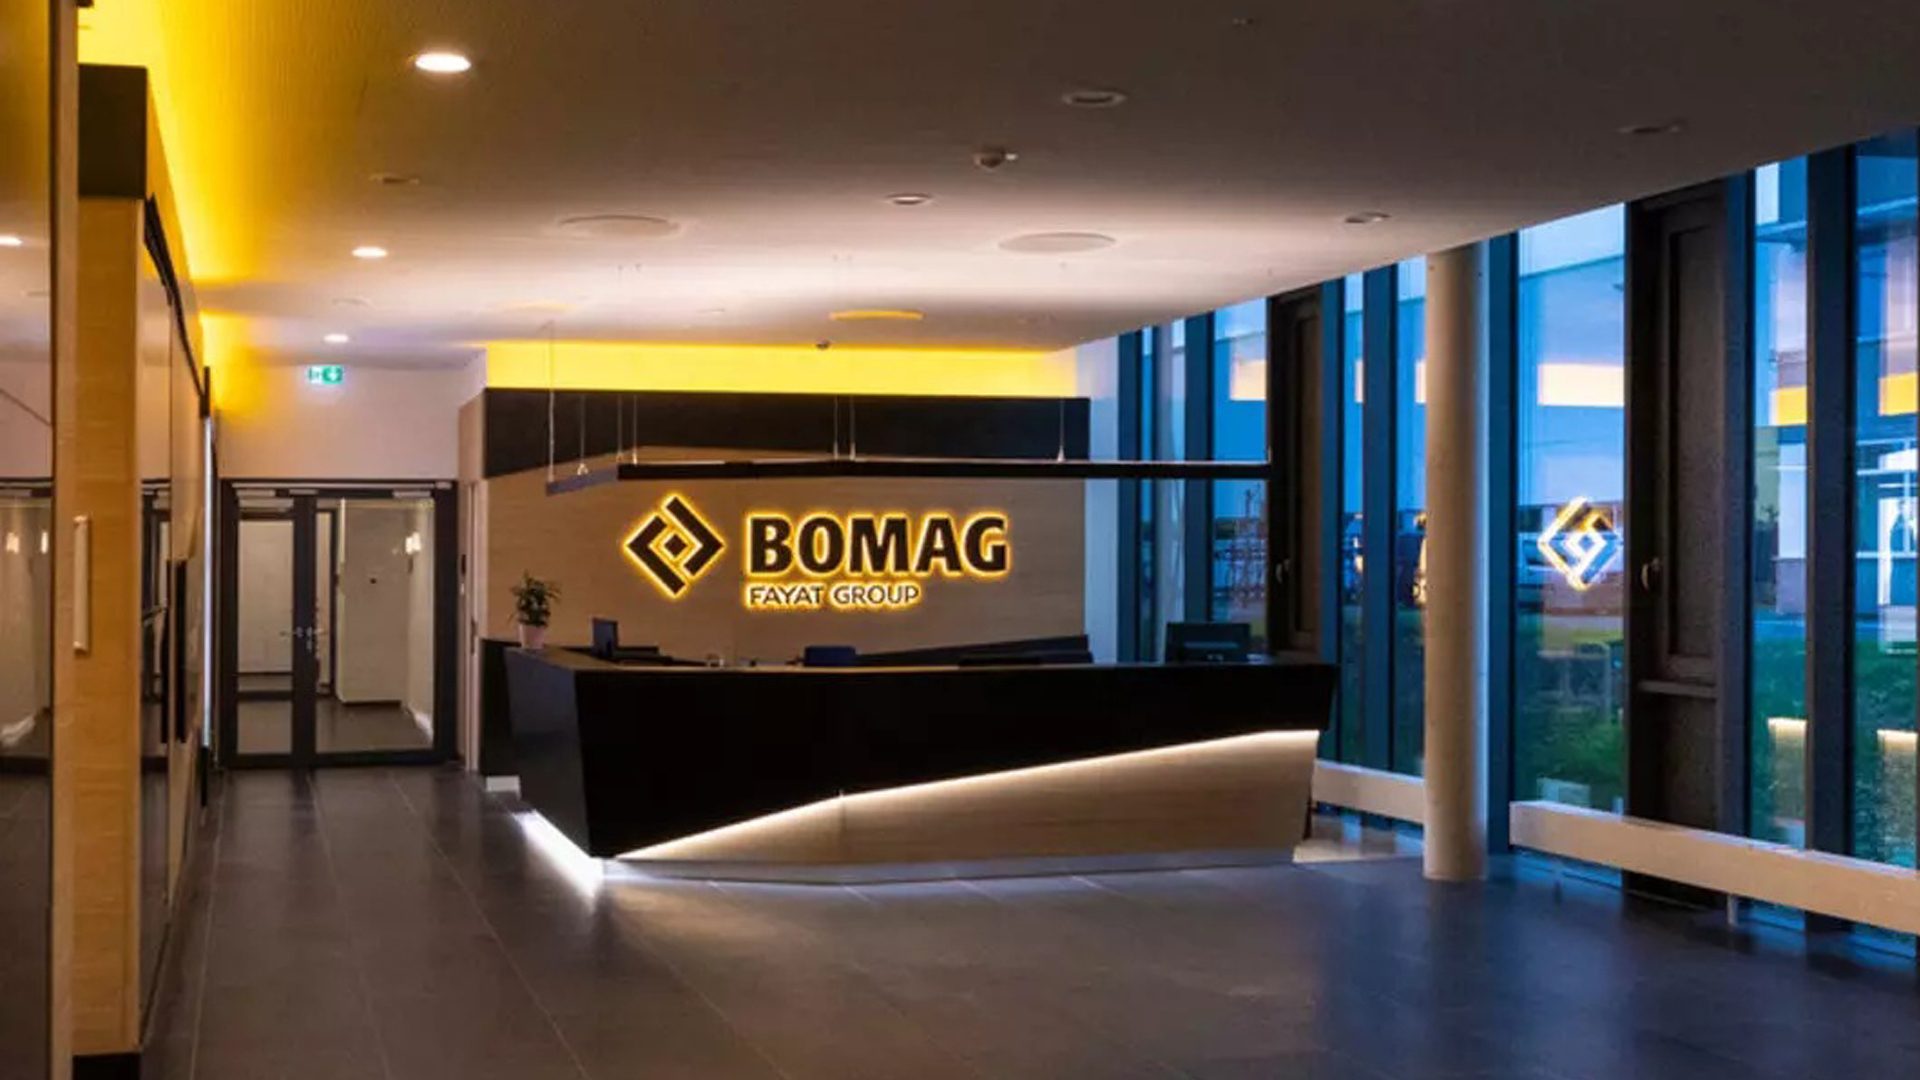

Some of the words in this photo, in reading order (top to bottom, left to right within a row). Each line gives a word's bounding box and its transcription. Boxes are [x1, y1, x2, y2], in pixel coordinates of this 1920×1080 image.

[749, 516, 1007, 574] BOMAG
[749, 586, 824, 605] FAYAT
[833, 585, 919, 605] GROUP
